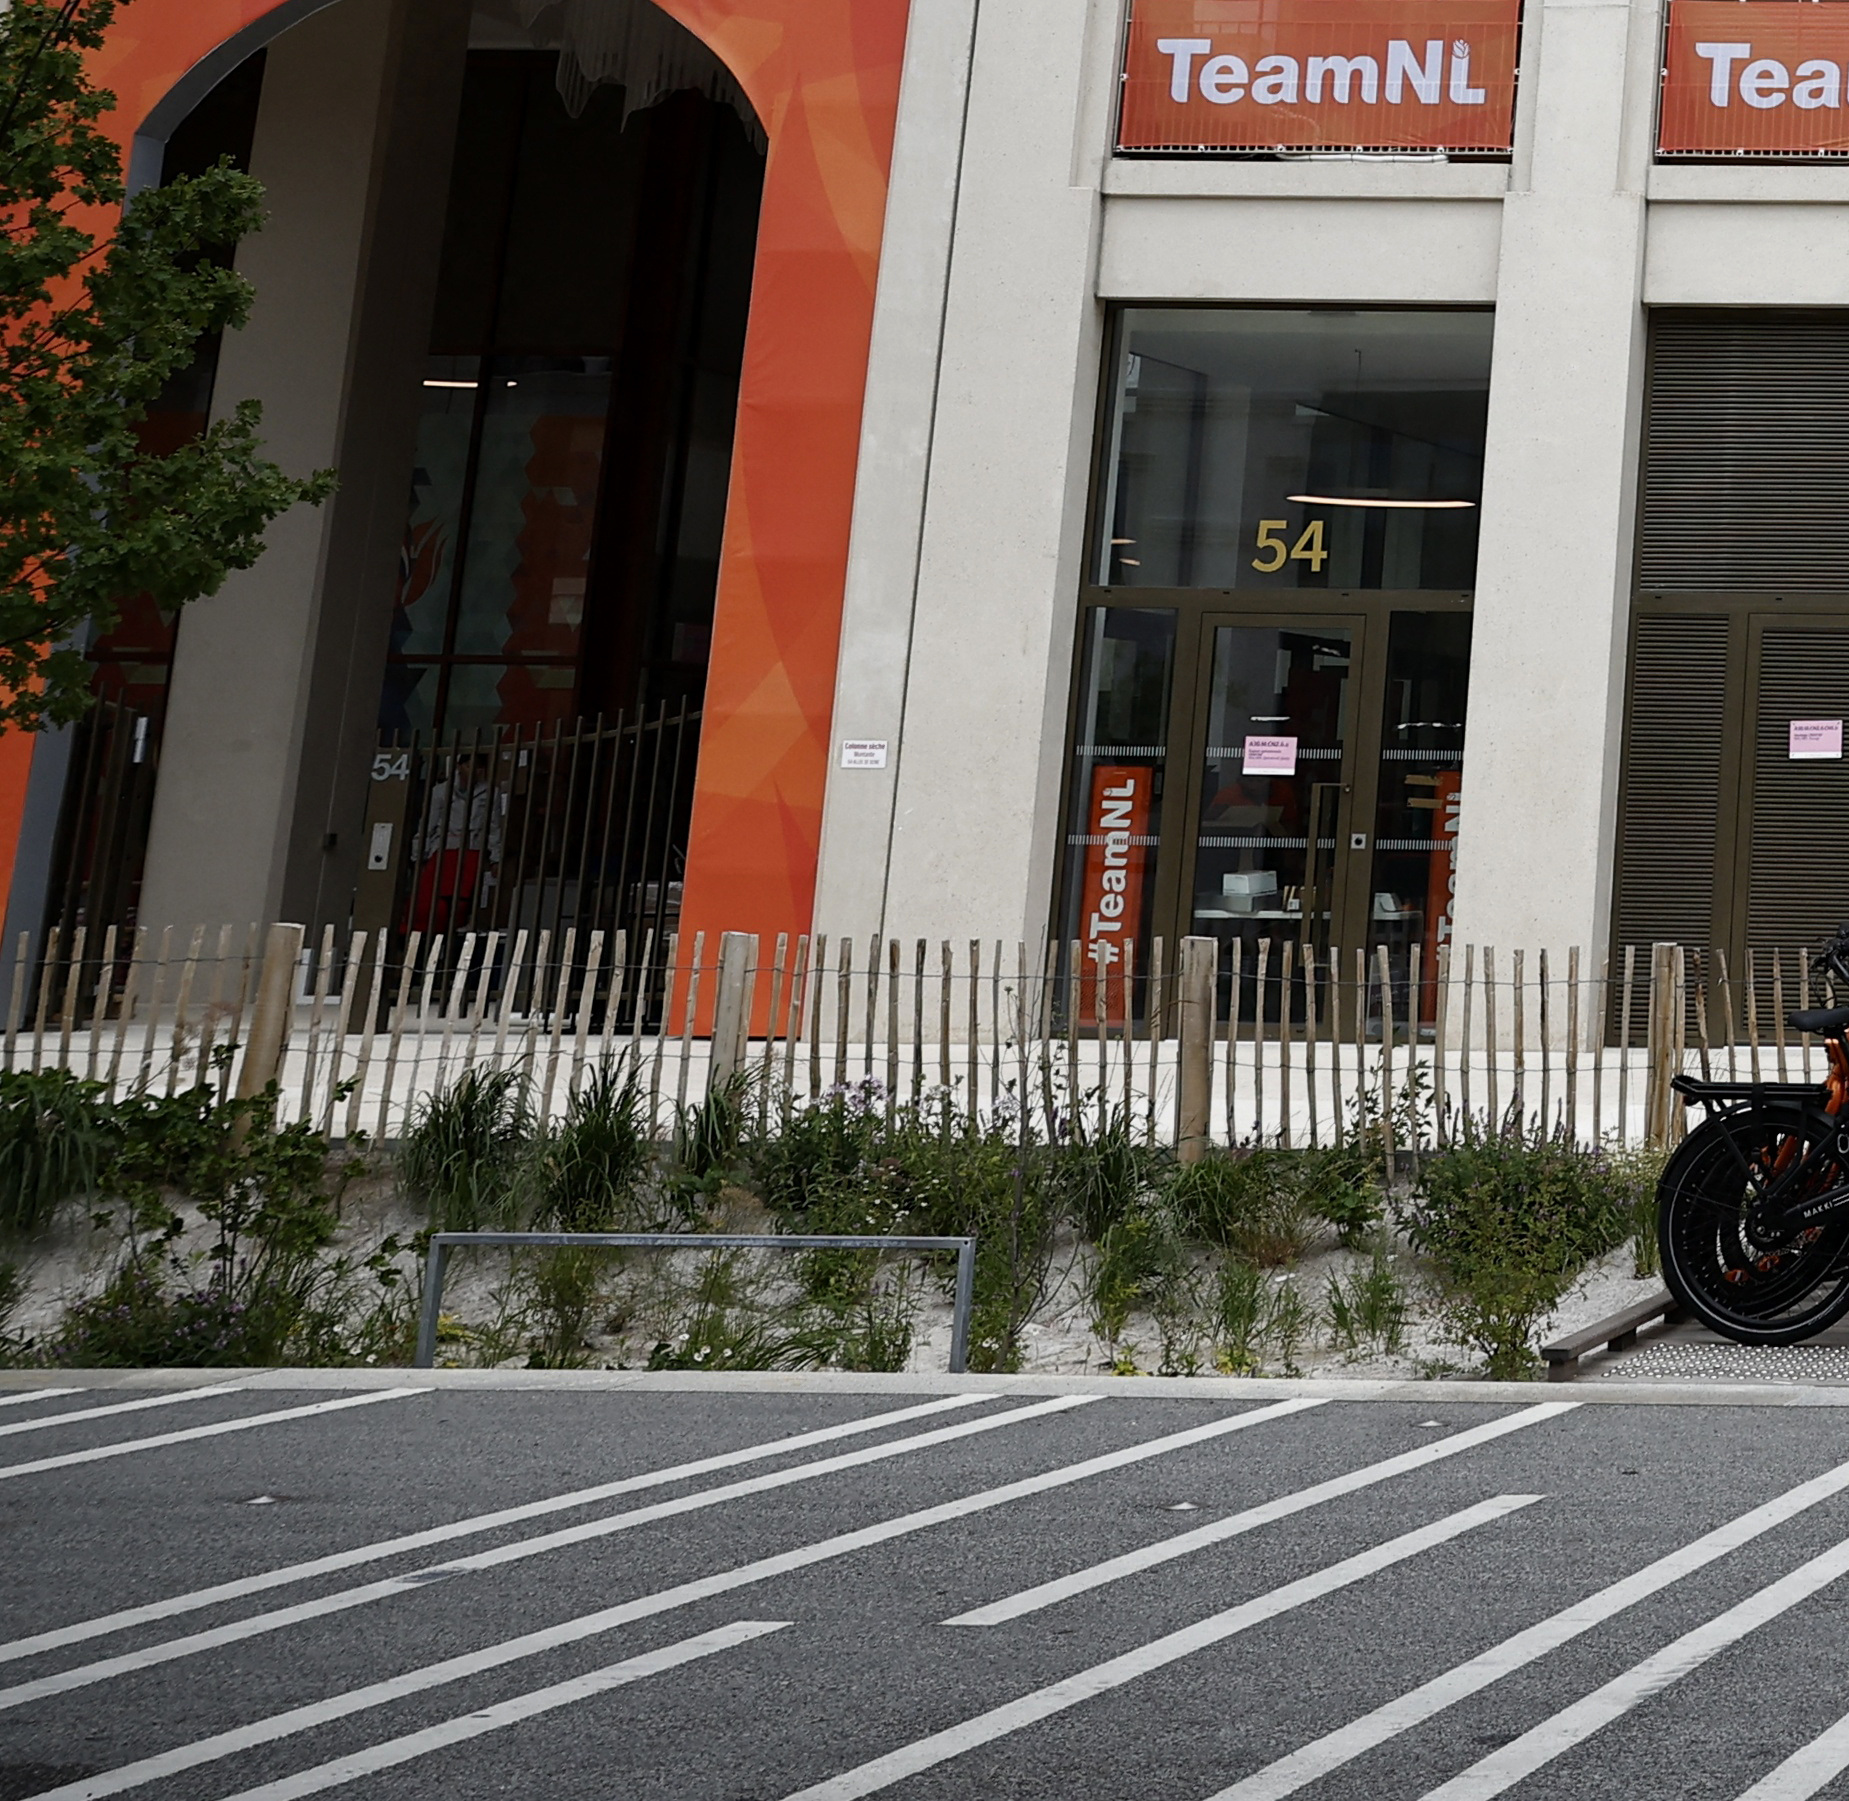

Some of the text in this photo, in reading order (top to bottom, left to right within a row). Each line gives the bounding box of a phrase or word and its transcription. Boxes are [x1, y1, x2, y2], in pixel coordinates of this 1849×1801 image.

[1158, 39, 1485, 104] TeamNL
[1251, 519, 1328, 573] 54
[371, 753, 410, 781] 54
[1803, 1201, 1833, 1219] MAKKI
